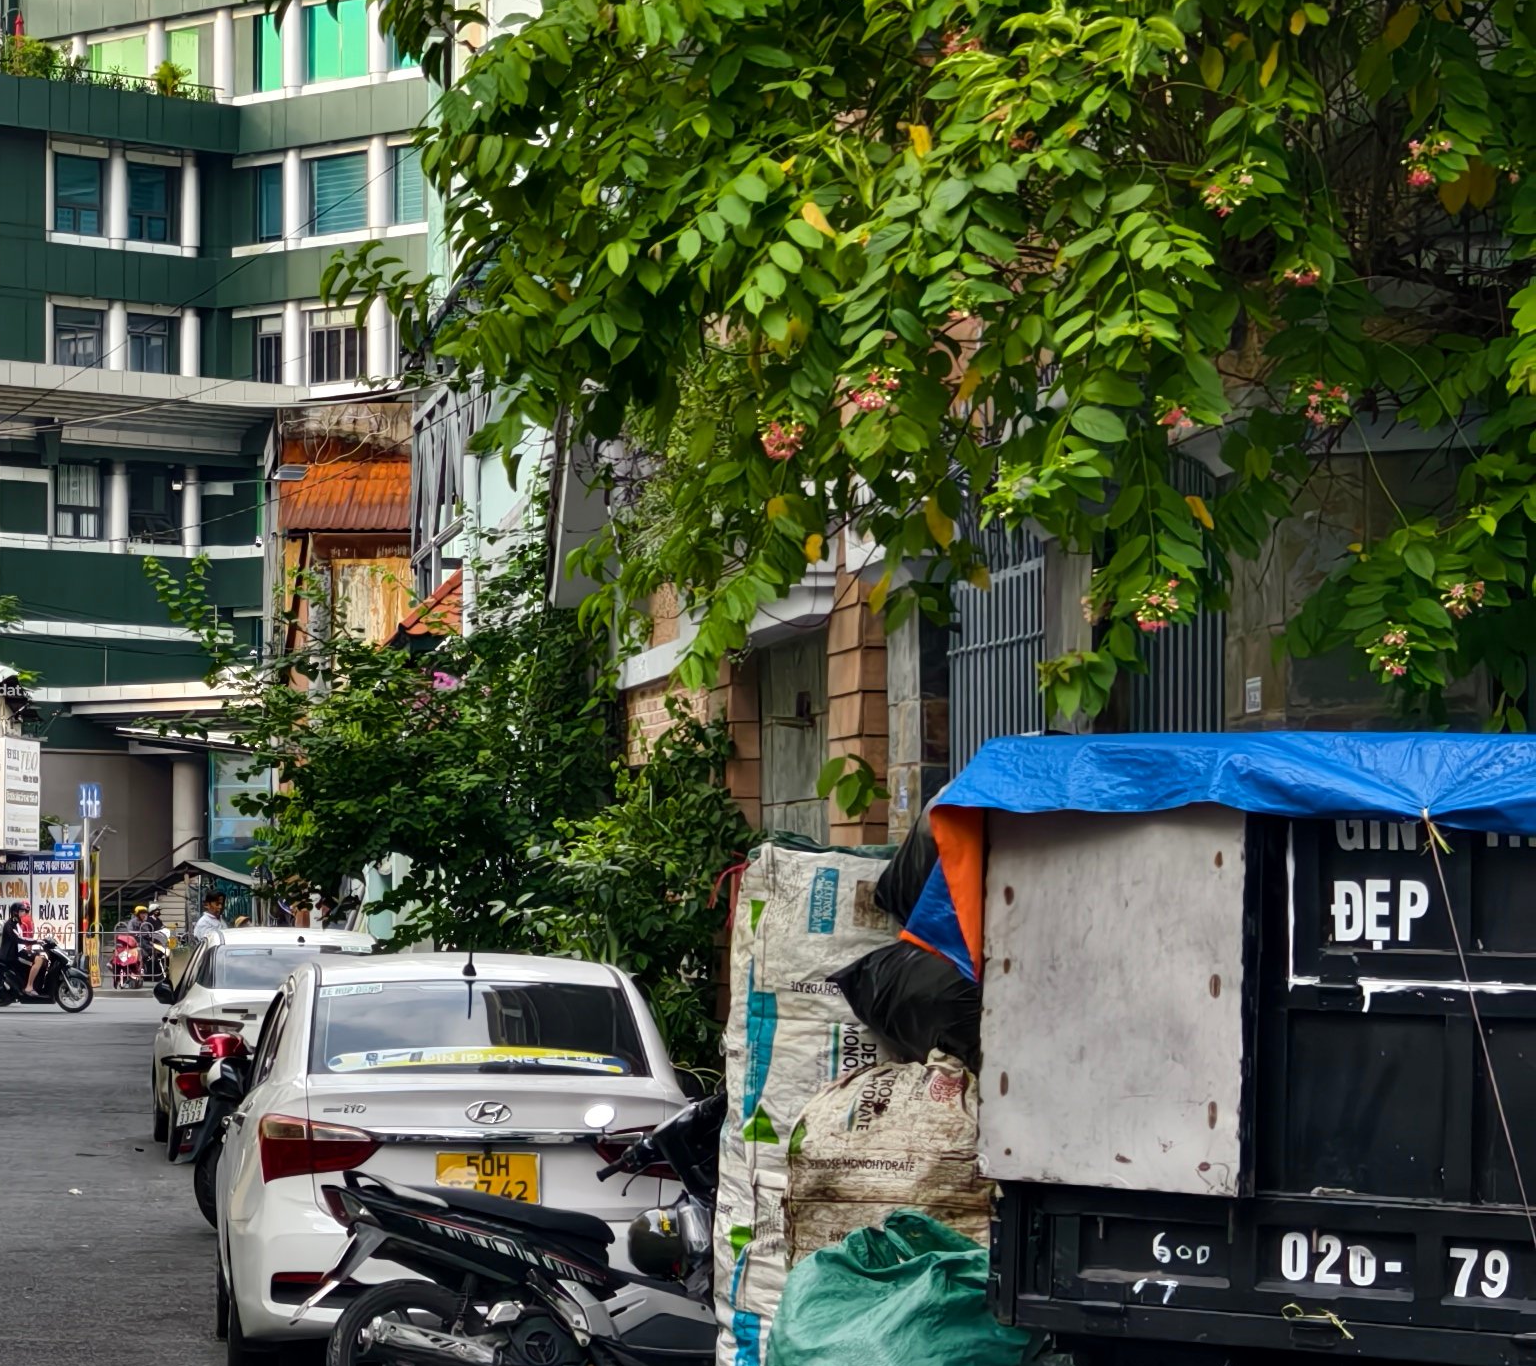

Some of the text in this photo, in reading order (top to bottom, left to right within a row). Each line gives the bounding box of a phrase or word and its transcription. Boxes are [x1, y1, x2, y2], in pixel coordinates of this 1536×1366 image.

[39, 877, 55, 898] VÁ
[58, 905, 69, 920] XE
[1330, 879, 1429, 950] ĐẸP
[843, 1022, 859, 1073] MONO
[466, 1154, 510, 1177] 50H
[1152, 1232, 1210, 1265] 600
[1449, 1248, 1510, 1299] 79
